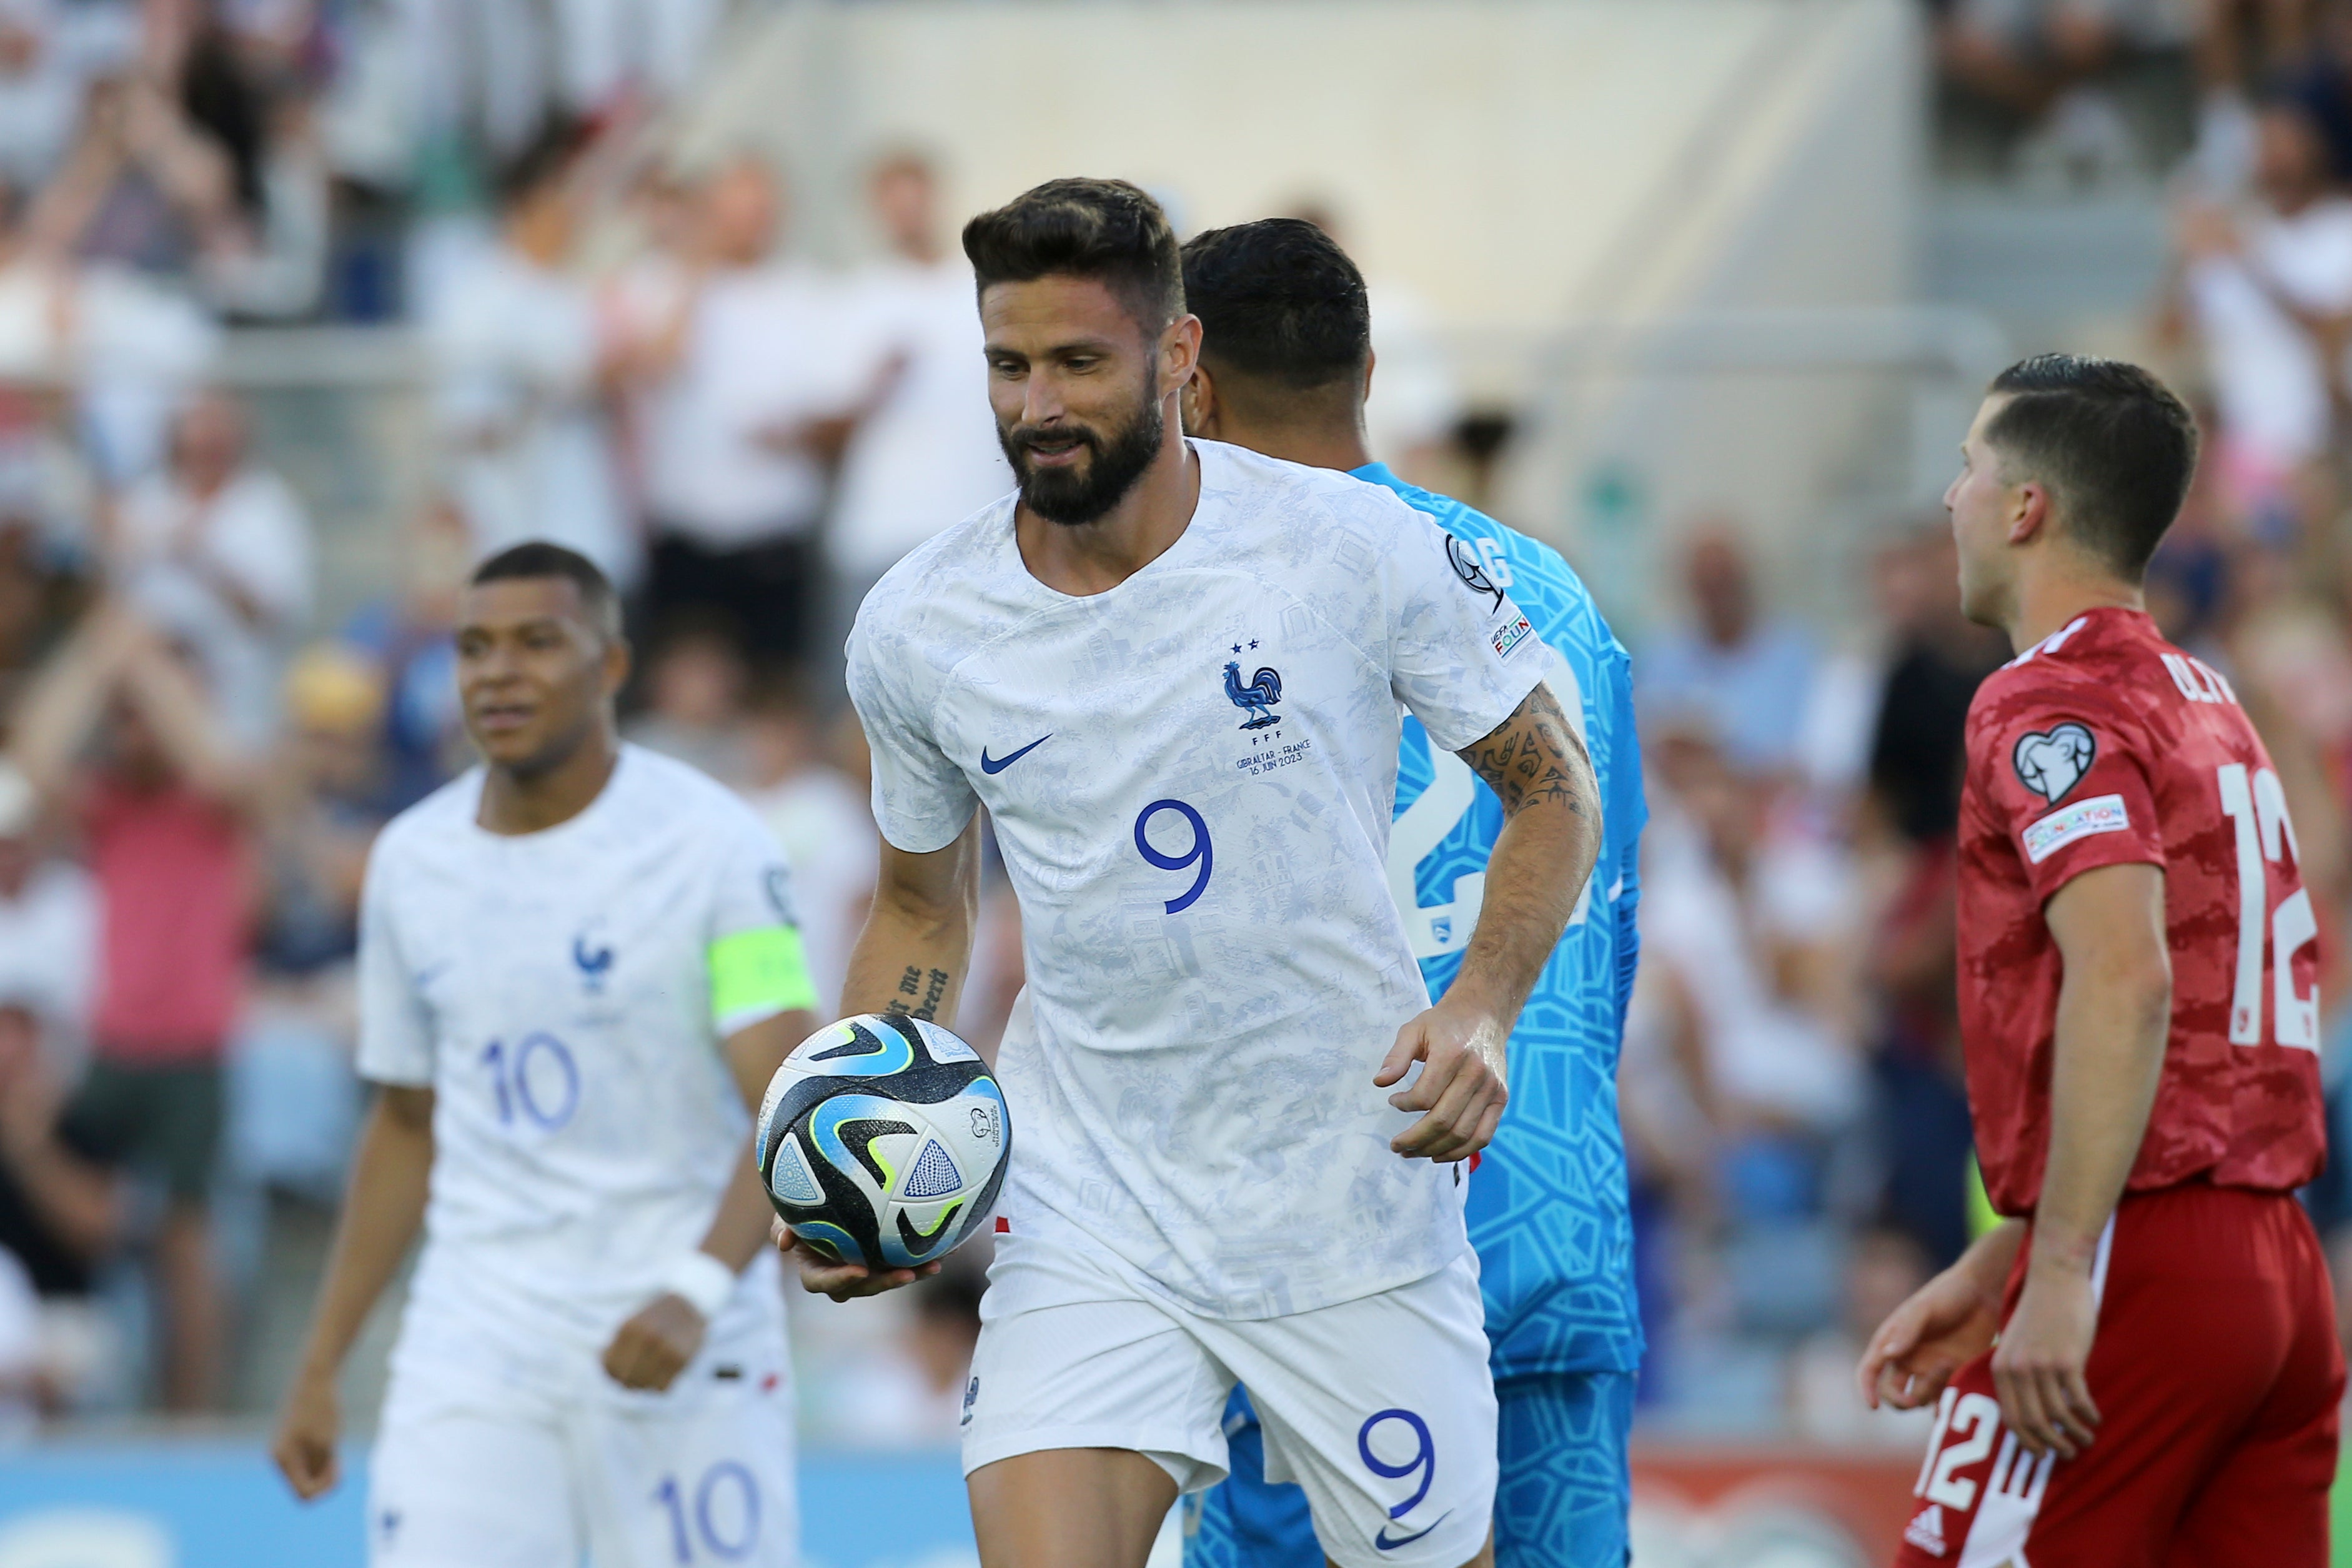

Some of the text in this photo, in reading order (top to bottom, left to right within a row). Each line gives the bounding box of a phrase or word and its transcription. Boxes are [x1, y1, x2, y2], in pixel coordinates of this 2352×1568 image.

[1491, 625, 1508, 644] UEFA
[1236, 750, 1276, 769] GIBRALTAR
[1283, 739, 1311, 756] FRANCE
[1249, 767, 1259, 776] 16
[1278, 752, 1303, 767] 2023
[1134, 799, 1213, 915] 9
[2217, 762, 2321, 1054] 12
[479, 1031, 580, 1129] 10
[1358, 1408, 1435, 1519] 9
[1913, 1385, 2002, 1512] 12
[651, 1461, 760, 1564] 10
